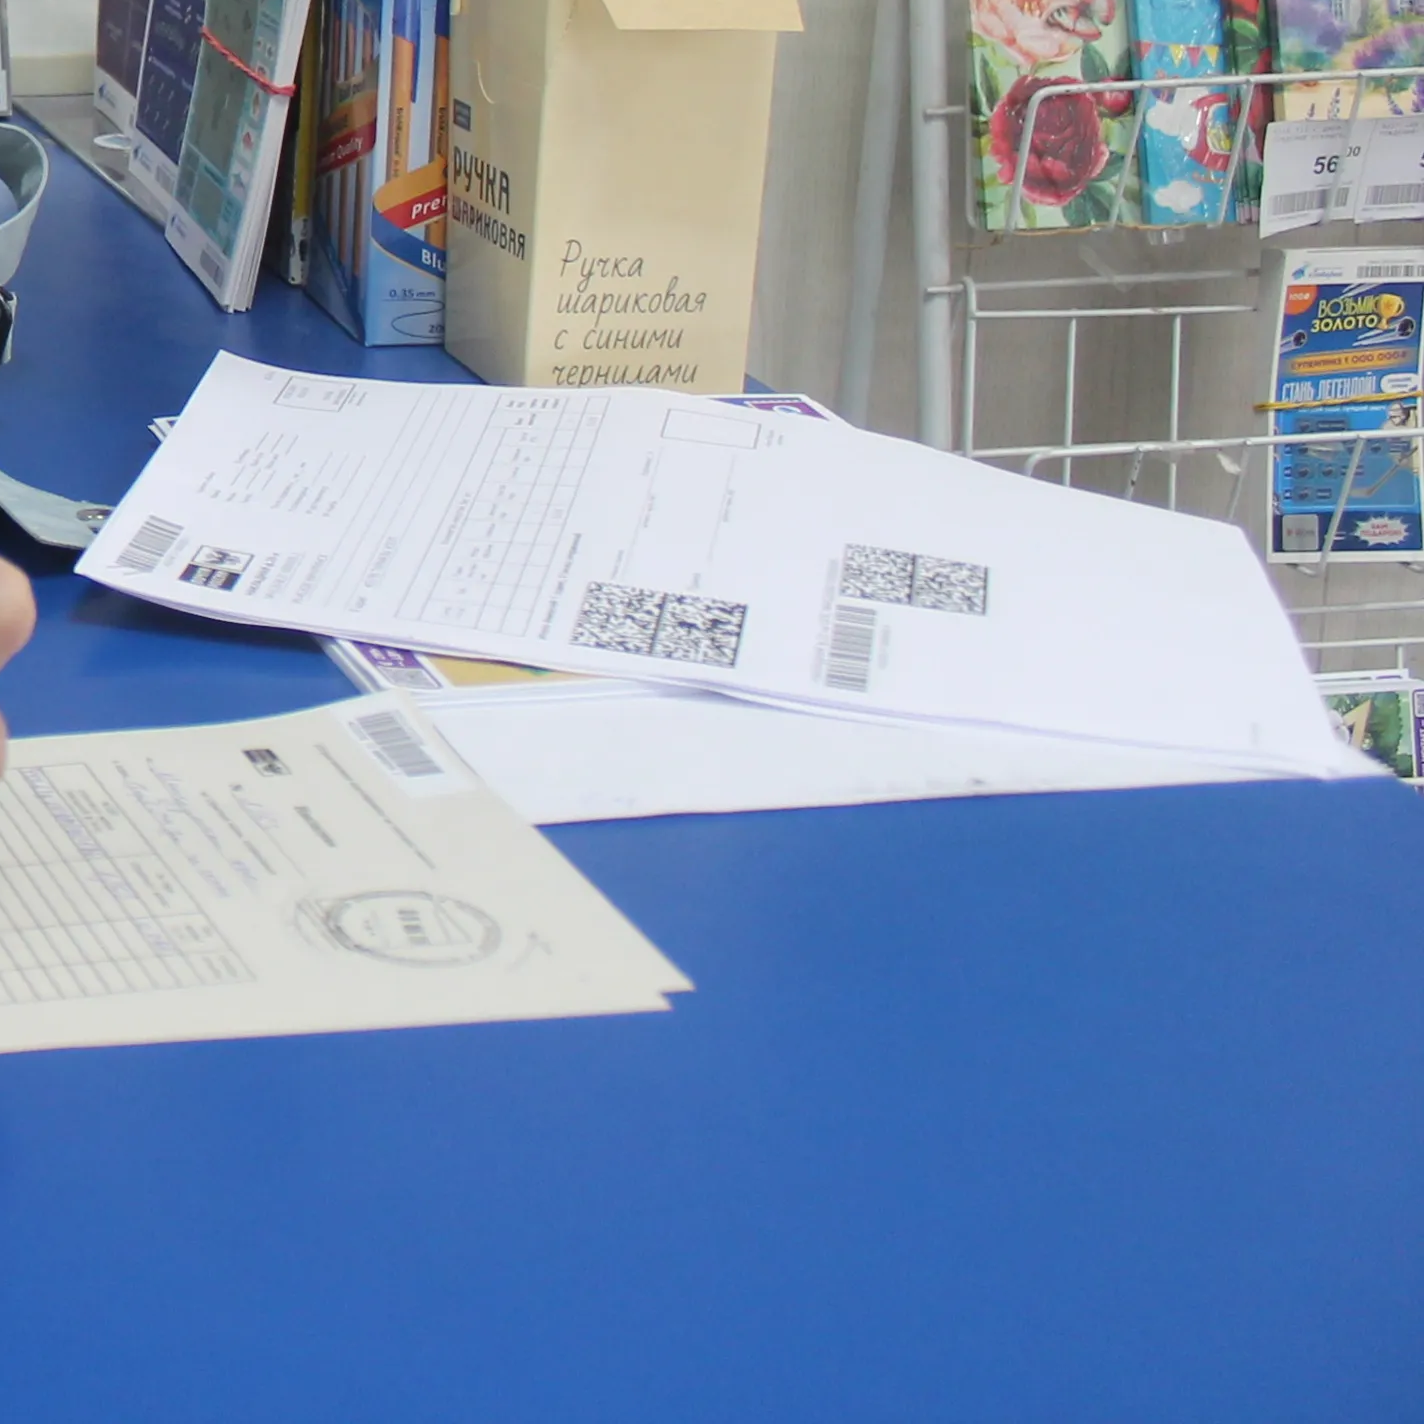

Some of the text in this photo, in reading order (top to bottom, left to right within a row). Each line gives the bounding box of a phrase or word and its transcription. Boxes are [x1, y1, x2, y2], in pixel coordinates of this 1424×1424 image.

[453, 145, 511, 216] РУЧКА
[452, 195, 527, 261] ШАРИКОВАЯ
[420, 248, 447, 273] Blu
[559, 239, 645, 293] Ручка
[556, 275, 708, 328] шариковая
[554, 327, 685, 351] с синими
[1310, 314, 1379, 334] ЗОЛОТО
[551, 363, 700, 388] чернилами
